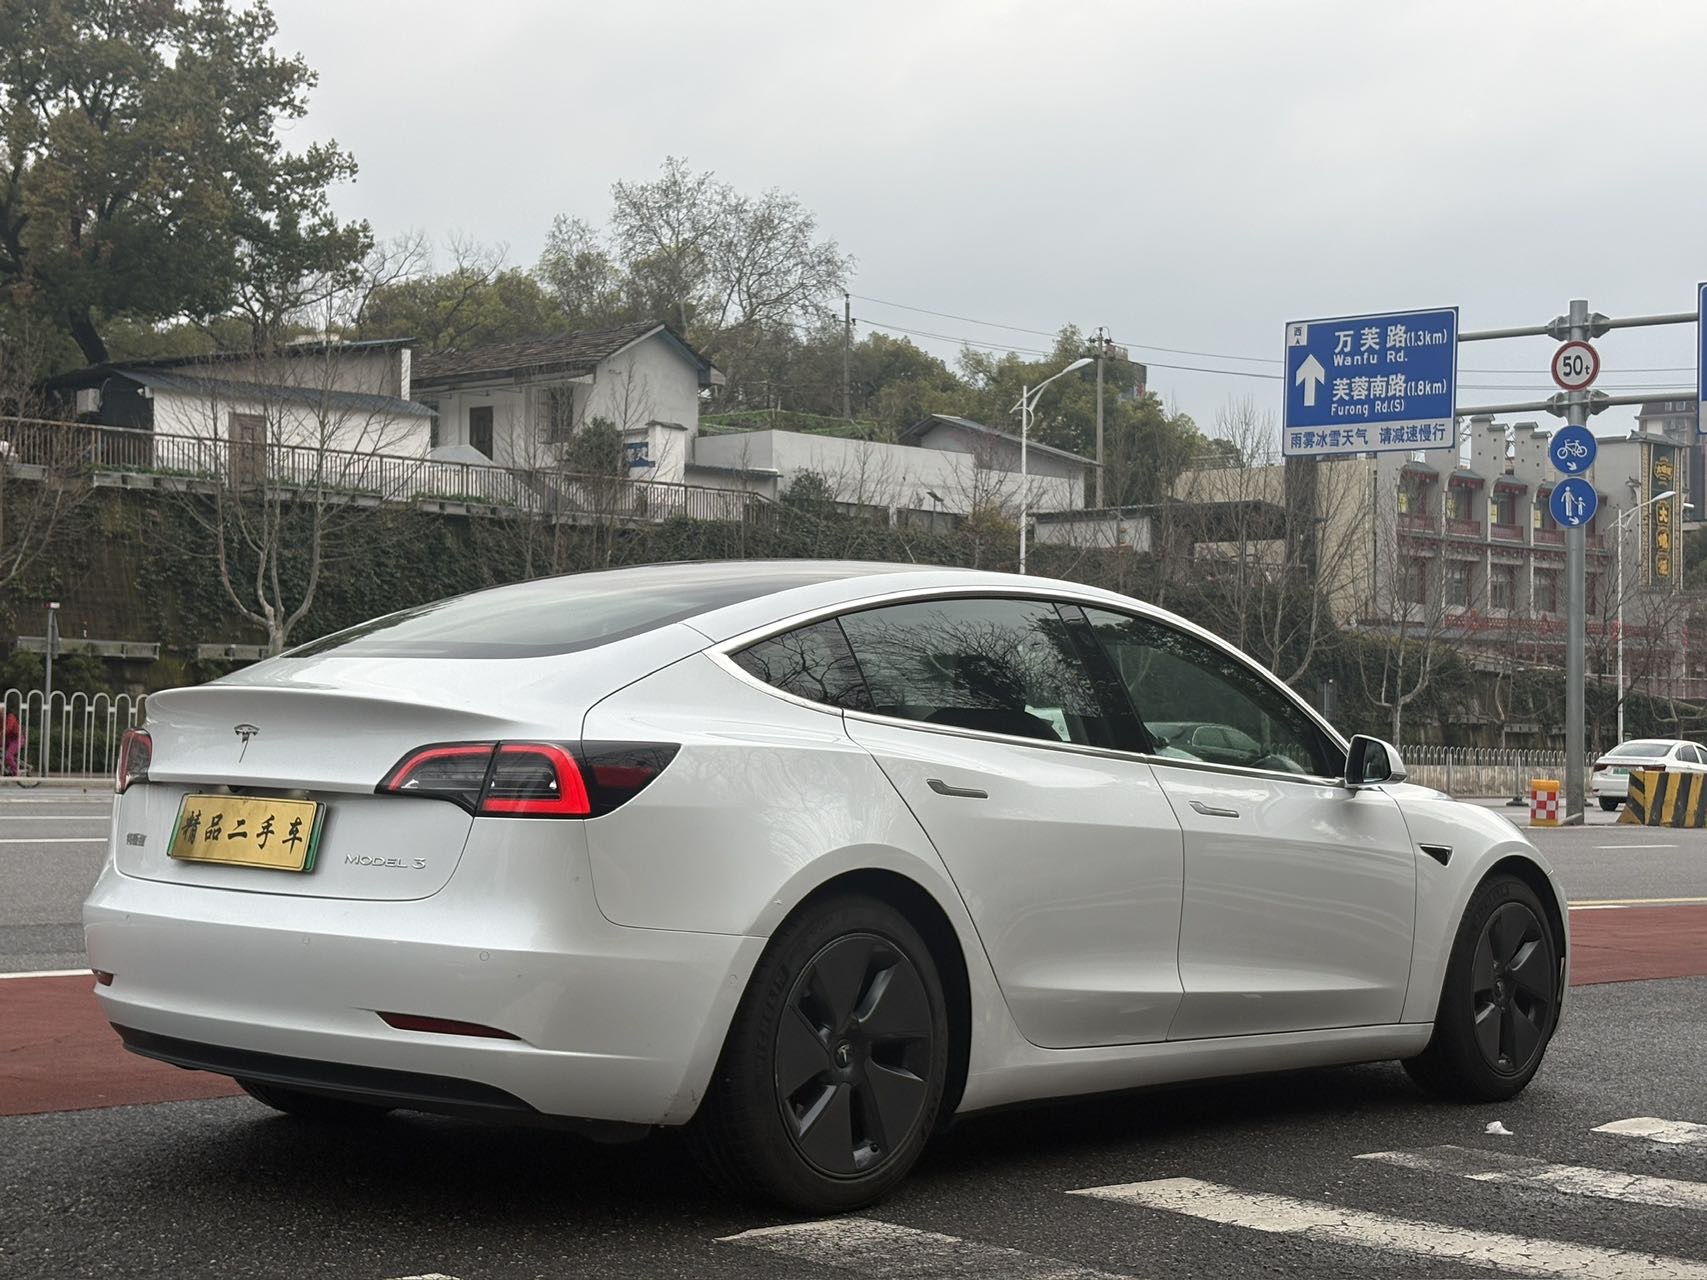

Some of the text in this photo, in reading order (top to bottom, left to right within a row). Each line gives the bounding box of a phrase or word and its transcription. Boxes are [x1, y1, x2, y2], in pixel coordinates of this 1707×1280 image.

[1333, 350, 1408, 367] Wanfu Rd.
[1331, 403, 1369, 417] Furong
[1290, 423, 1446, 449] 雨雾冰雪天气 请减速慢行
[182, 810, 303, 855] 精品二手车
[344, 853, 427, 870] MODEL 3
